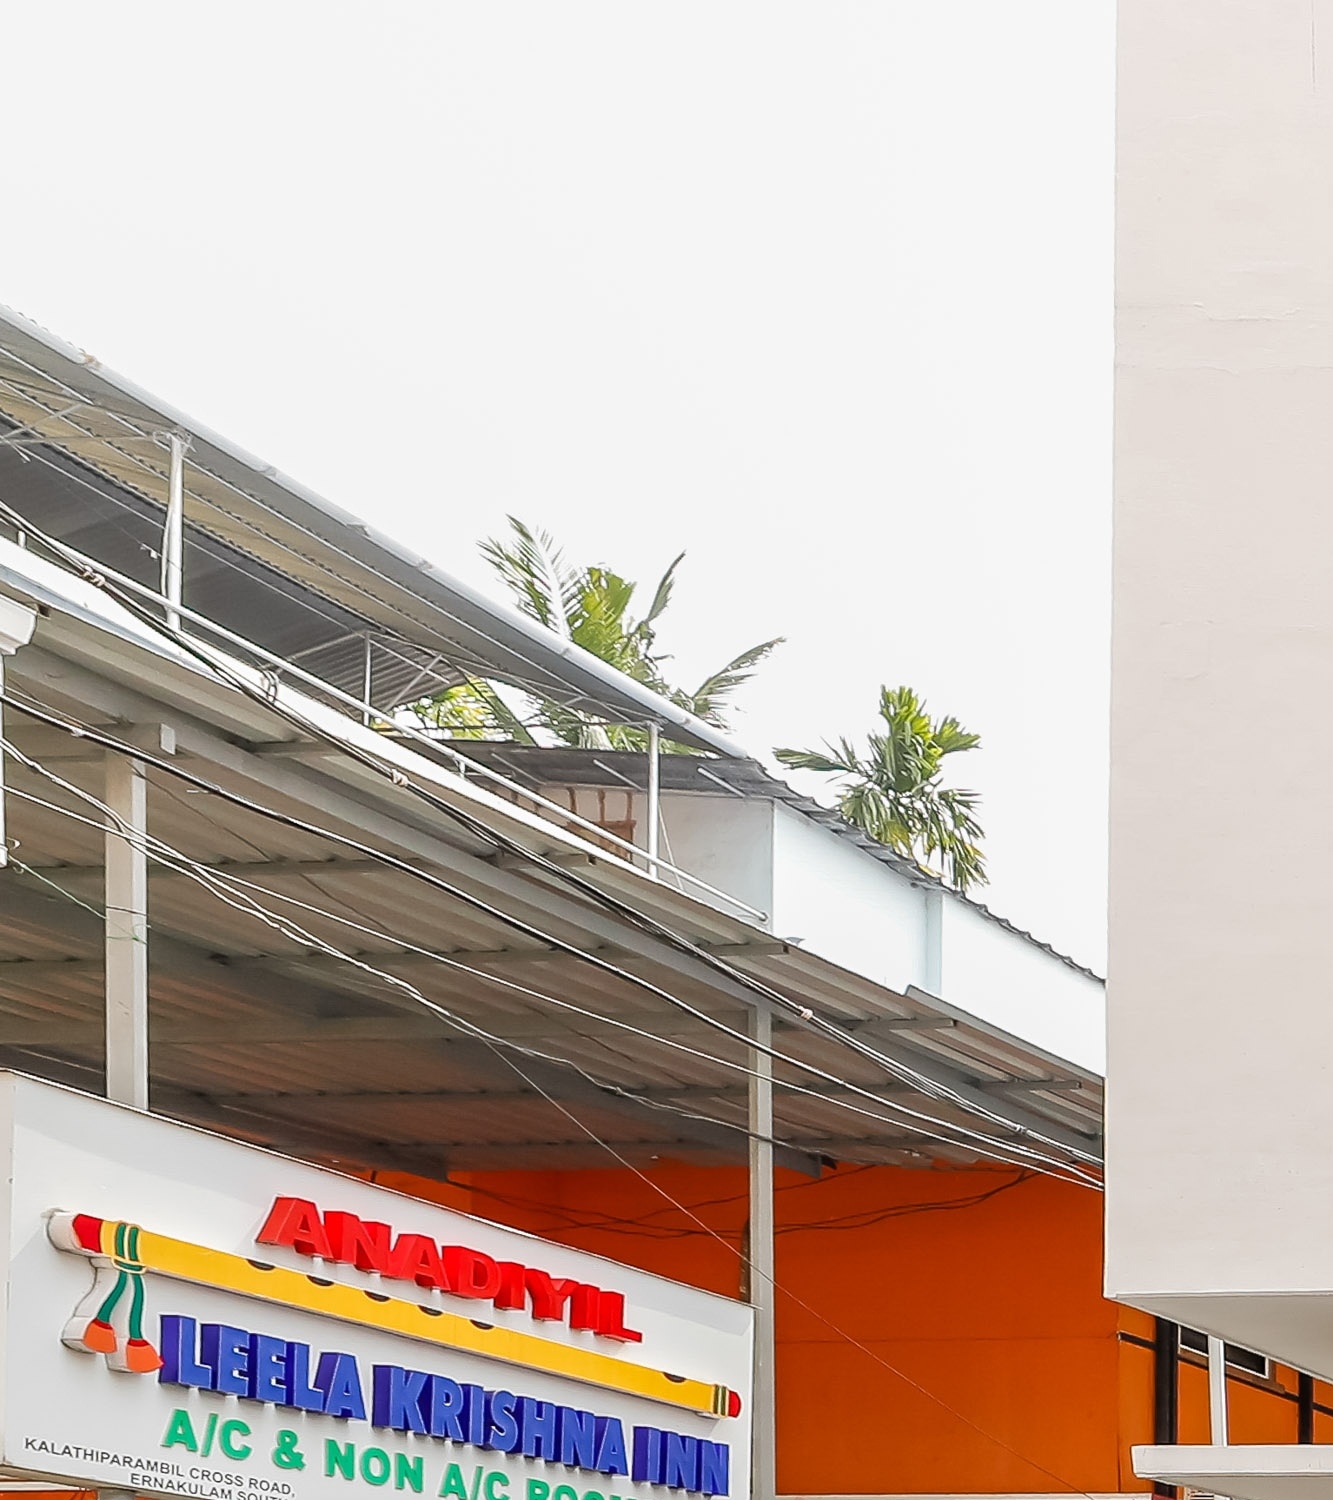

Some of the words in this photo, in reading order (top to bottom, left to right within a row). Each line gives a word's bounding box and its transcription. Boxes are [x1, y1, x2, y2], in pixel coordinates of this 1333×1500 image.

[256, 1195, 643, 1344] ANADIYIL
[157, 1314, 367, 1421] LEELA
[371, 1364, 629, 1477] KRISHNA
[631, 1426, 730, 1497] INN
[24, 1437, 185, 1477] KALATHIPARAMBIL
[189, 1467, 244, 1487] CROSS
[248, 1477, 296, 1498] ROAD,
[130, 1473, 233, 1500] ERNAKULAM
[159, 1408, 253, 1461] A/C
[273, 1429, 306, 1470] &
[325, 1439, 424, 1494] NON
